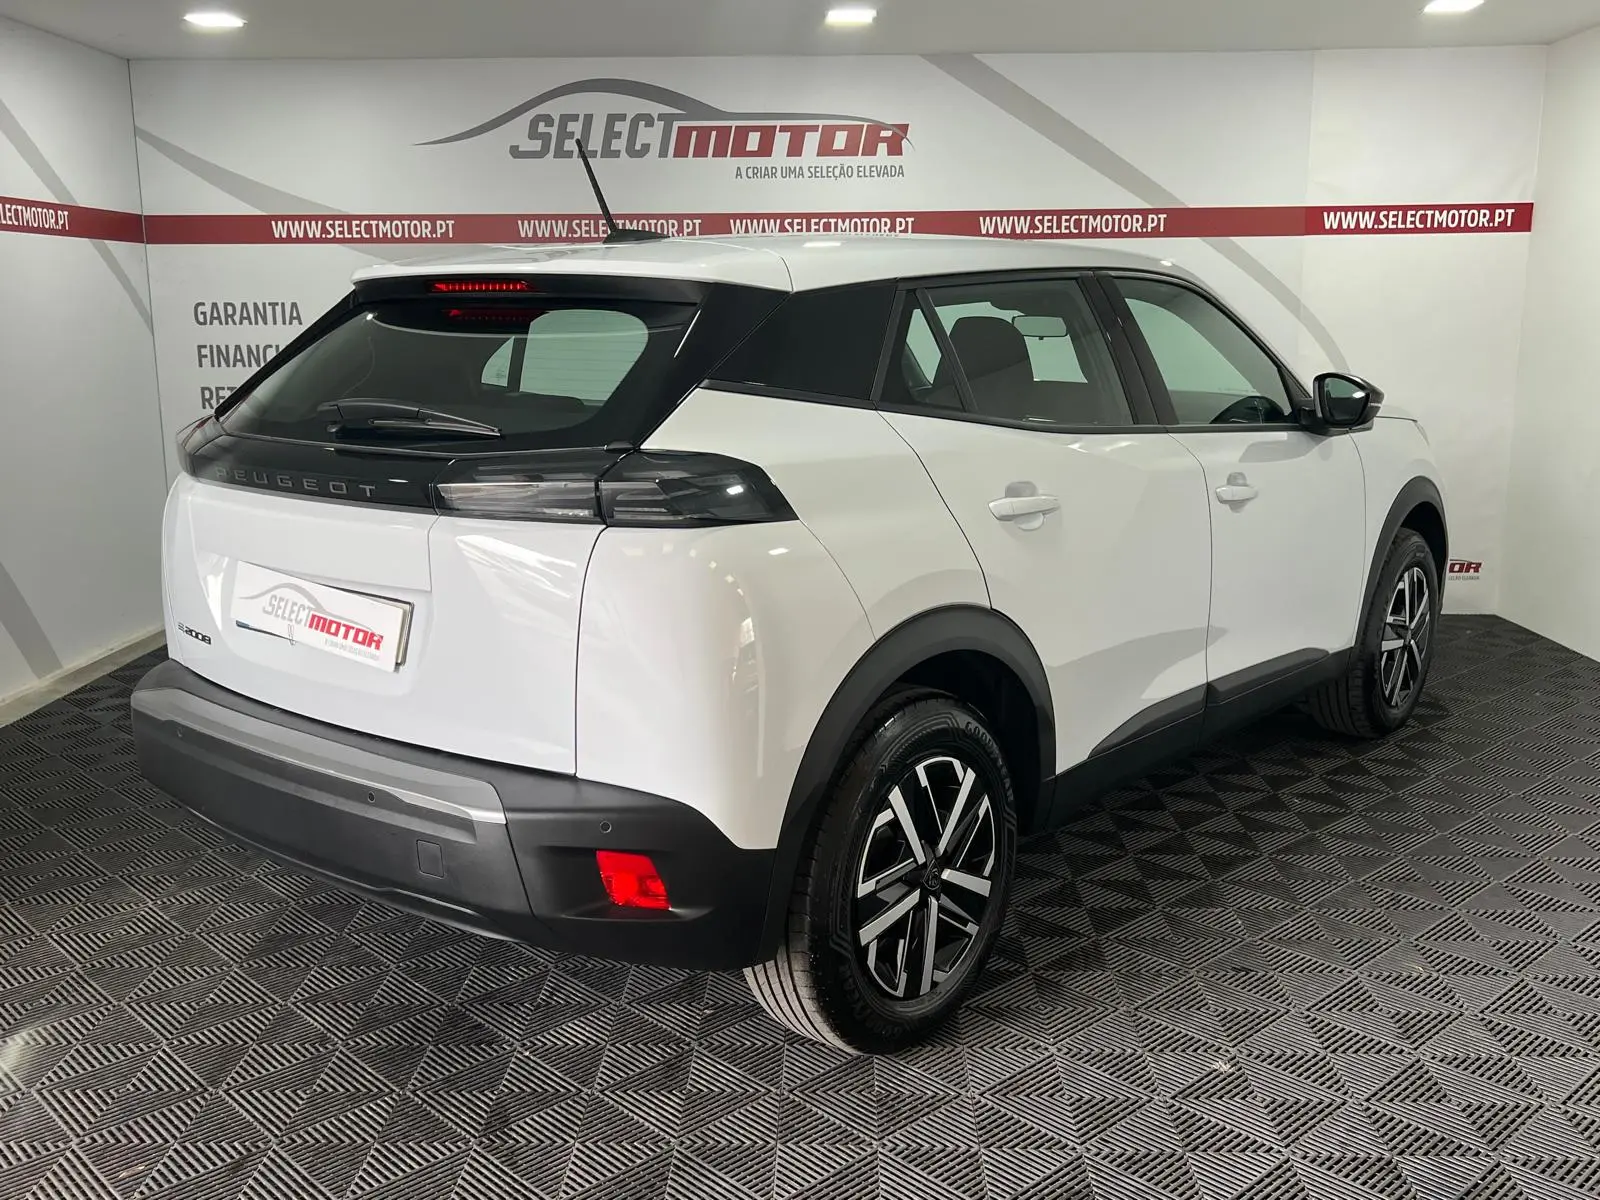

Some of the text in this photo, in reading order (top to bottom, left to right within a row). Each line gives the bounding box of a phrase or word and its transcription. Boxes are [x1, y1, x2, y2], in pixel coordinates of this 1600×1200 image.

[735, 163, 905, 180] A CRIAR UMA SELEÇÃO ELEVADA
[518, 219, 702, 238] WWW.SELETMOTOR.PT
[730, 218, 915, 234] WWWSELECTMOTOR.PT
[979, 214, 1167, 234] WWW.SELECTMOTOR.PT
[1323, 209, 1515, 230] WWW.SELECTMOTOR.PT
[271, 220, 455, 239] WWW.SELECTMOTOR.PT
[193, 301, 303, 326] GARANTIA
[215, 466, 376, 498] PEUGEOT
